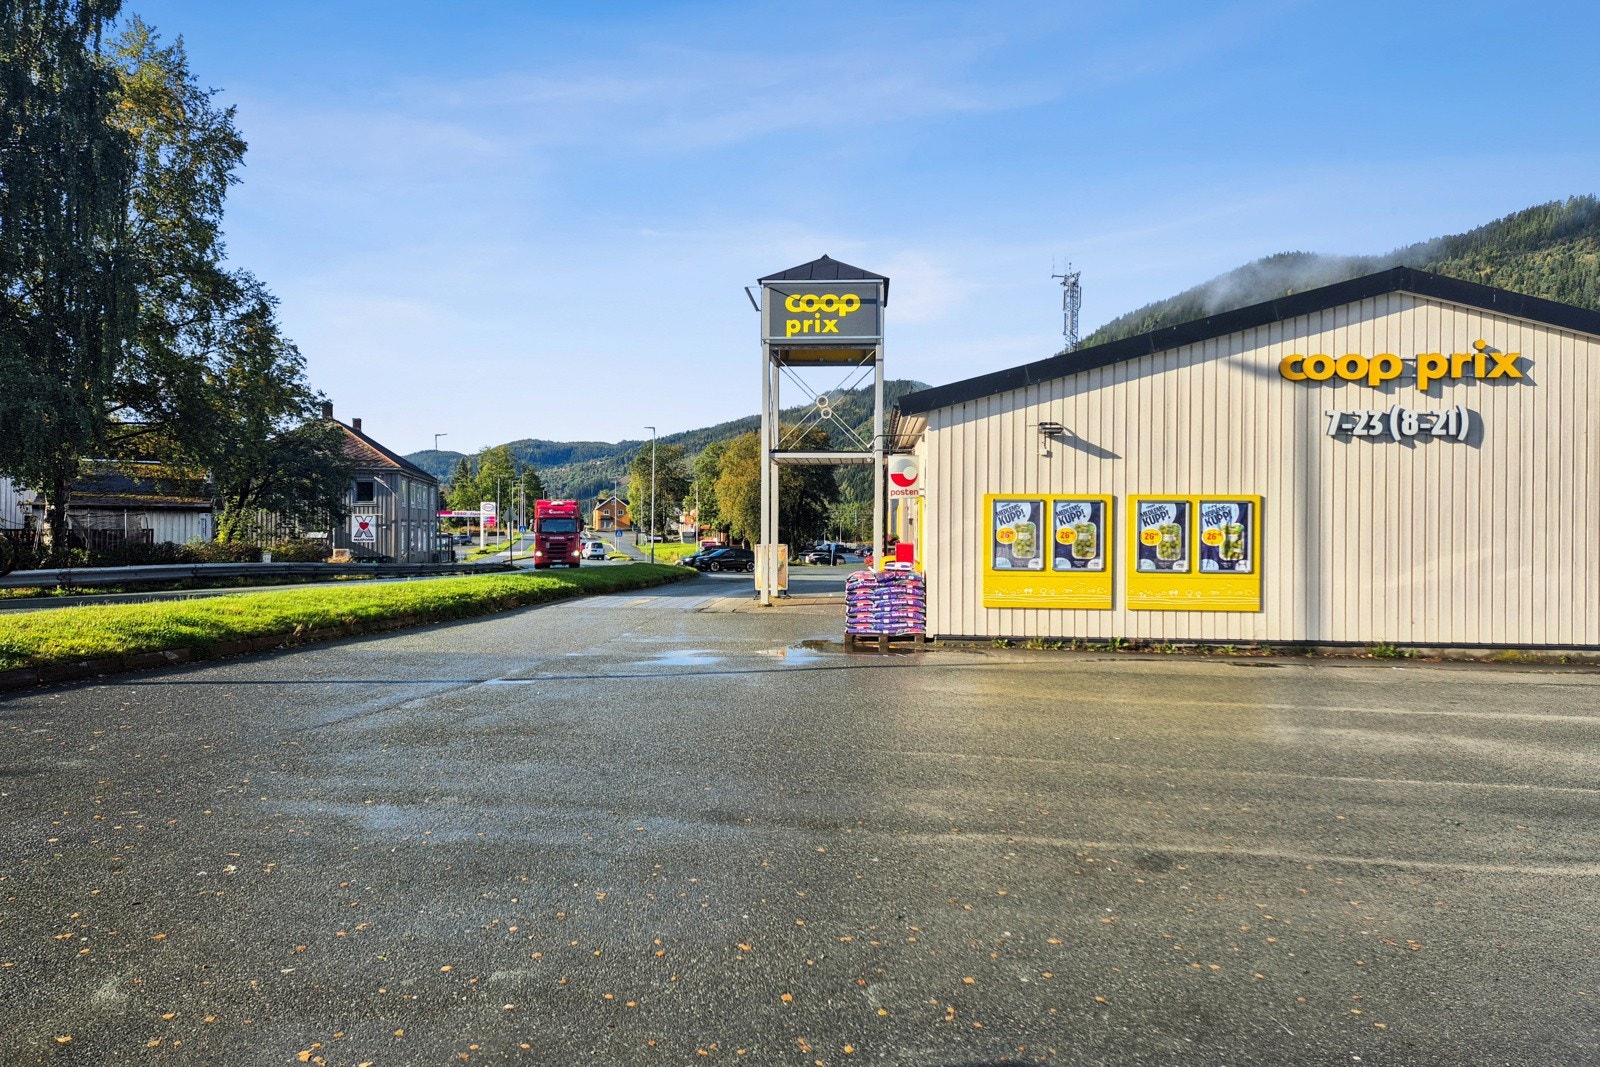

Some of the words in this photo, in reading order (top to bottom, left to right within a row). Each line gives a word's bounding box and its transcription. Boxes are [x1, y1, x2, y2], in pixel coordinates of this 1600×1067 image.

[784, 293, 861, 317] coop
[785, 312, 839, 338] prix
[1279, 353, 1403, 387] coop
[1416, 339, 1523, 390] prix
[1325, 410, 1383, 436] 7-23
[1389, 404, 1470, 441] (8-21)
[890, 488, 919, 497] posten
[998, 508, 1026, 526] KUPP!
[1058, 509, 1086, 526] KUPP!
[1142, 510, 1171, 527] KUPP!
